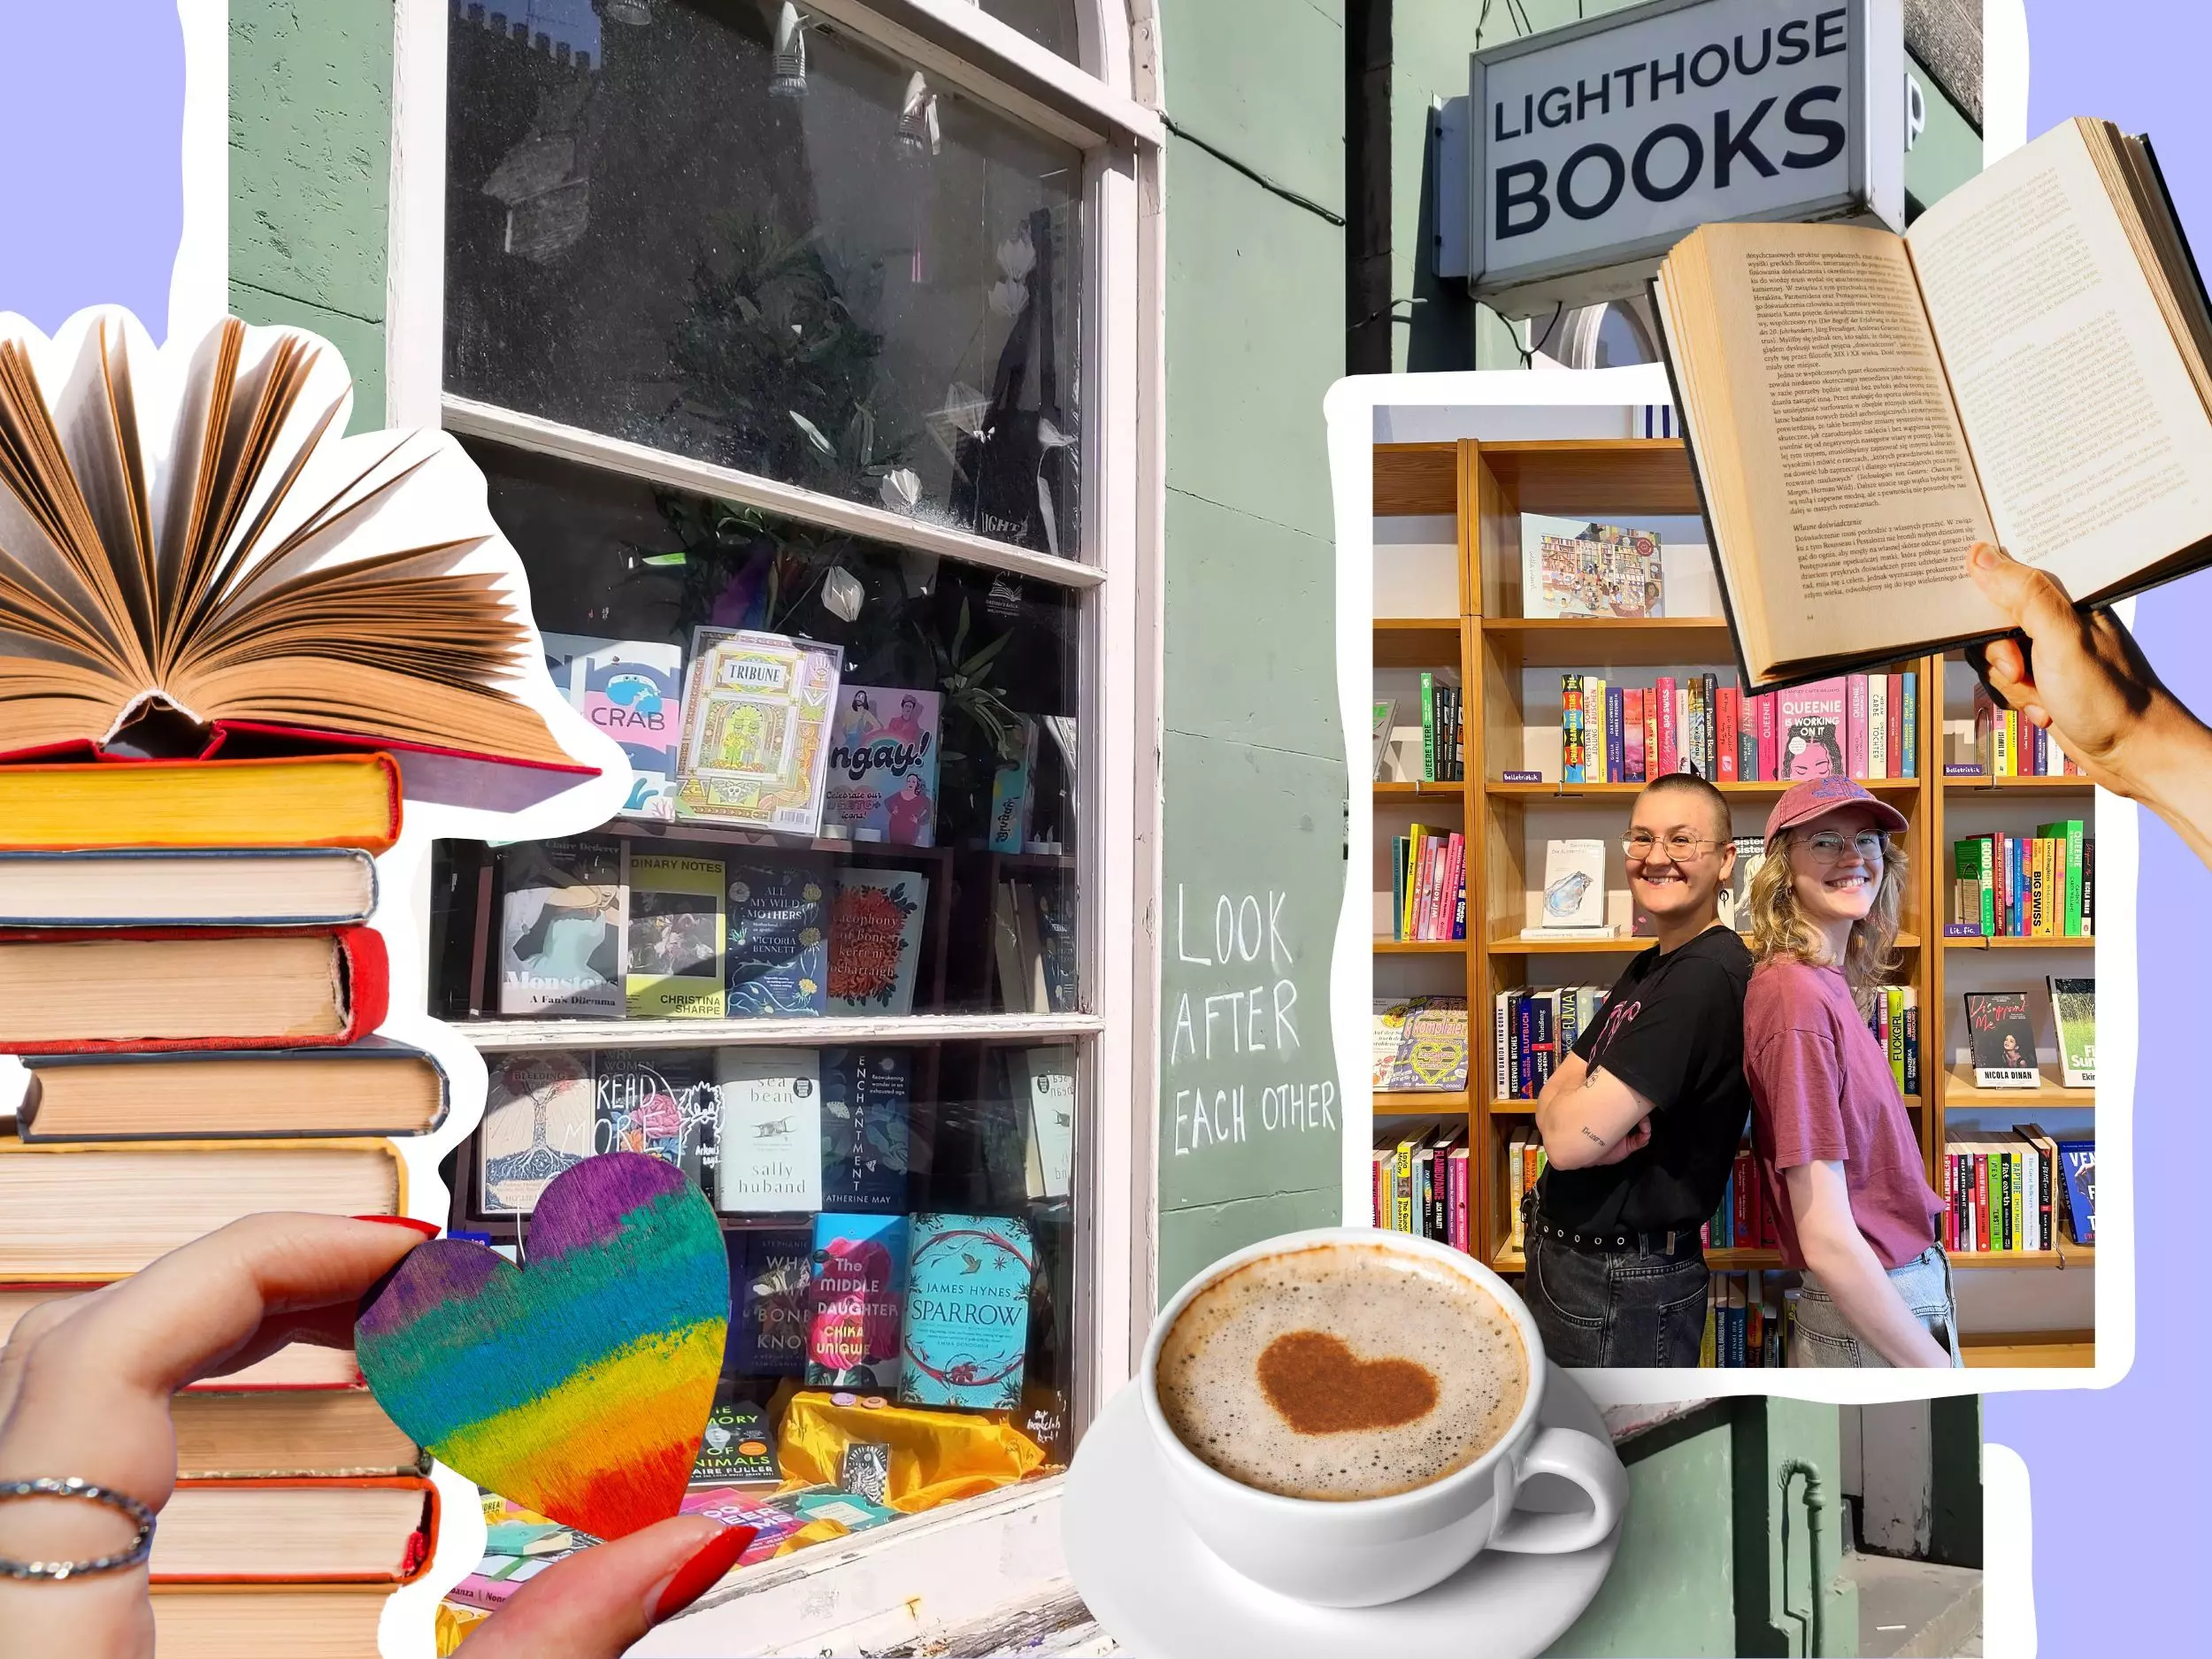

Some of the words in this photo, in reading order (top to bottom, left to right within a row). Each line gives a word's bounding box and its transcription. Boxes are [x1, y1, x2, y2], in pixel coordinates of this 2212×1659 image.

[1495, 7, 1847, 142] LIGHTHOUSE
[1495, 85, 1847, 241] BOOKS
[1794, 533, 1839, 541] Doświadczenie
[1856, 535, 1886, 545] Pestalozzi
[1867, 573, 1886, 582] Jednak
[730, 664, 780, 682] TRIBUNE
[1783, 701, 1842, 716] QUEENIE
[591, 707, 664, 731] CRAB
[1794, 717, 1839, 726] WORKING
[1569, 723, 1578, 764] CHAIN-GANG
[831, 731, 932, 780] ngay!
[1734, 837, 1764, 846] sister
[1983, 842, 1992, 869] GOOD
[681, 862, 722, 872] NOTES
[1983, 871, 1992, 891] GIRL
[765, 887, 785, 895] ALL
[751, 899, 765, 908] MY
[771, 899, 800, 908] WILD
[748, 910, 803, 920] MOTHERS
[1179, 883, 1294, 966] LOOK
[1963, 926, 1976, 936] fic.
[753, 936, 796, 945] VICTORIA
[531, 995, 537, 1004] A
[542, 995, 566, 1004] Fan's
[572, 995, 615, 1006] Dilemma
[660, 995, 720, 1005] CHRISTINA
[676, 1005, 720, 1015] SHARPE
[1563, 995, 1575, 1029] FULVIA
[1970, 995, 2026, 1021] Disappoint
[1171, 979, 1301, 1065] AFTER
[1975, 1015, 1995, 1031] Me
[1893, 1012, 1901, 1061] FUCKGIRL
[757, 1078, 786, 1087] sea
[1984, 1071, 2008, 1080] NICOLA
[2010, 1071, 2032, 1080] DINAN
[597, 1074, 656, 1109] READ
[750, 1088, 793, 1103] bean
[852, 1056, 866, 1191] ENCHANTMENT
[1175, 1084, 1246, 1156] EACH
[1262, 1080, 1336, 1132] OTHER
[560, 1110, 665, 1158] MORE
[752, 1163, 793, 1179] sally
[1434, 1150, 1444, 1200] FLAMBOYANCE
[739, 1180, 805, 1194] huband
[835, 1258, 863, 1271] The
[820, 1279, 879, 1293] MIDDLE
[927, 1283, 964, 1294] JAMES
[970, 1286, 1011, 1297] HYNES
[818, 1302, 898, 1317] DAUGHTER
[911, 1300, 1023, 1326] SPARROW
[824, 1326, 864, 1337] CHIKA
[817, 1344, 871, 1355] UNIGWE
[707, 1447, 733, 1455] OF
